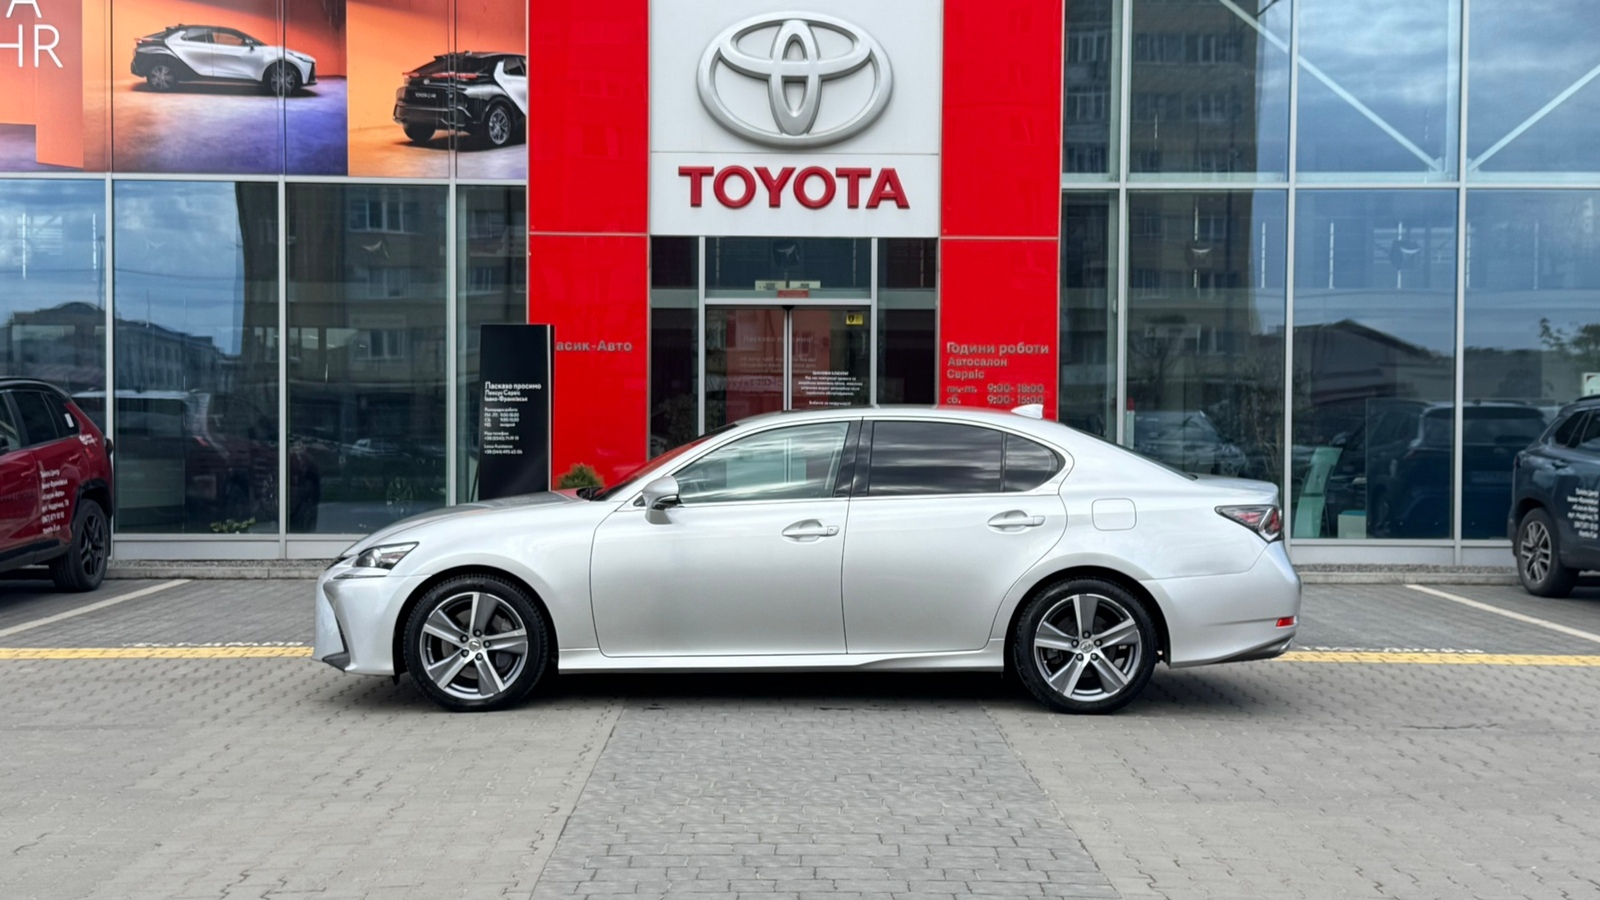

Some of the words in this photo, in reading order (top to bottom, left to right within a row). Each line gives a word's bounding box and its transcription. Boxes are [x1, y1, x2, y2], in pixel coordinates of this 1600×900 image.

[678, 165, 910, 209] TOYOTA
[947, 342, 995, 355] Години
[999, 342, 1049, 356] роботи
[947, 357, 1007, 367] Автосалон
[947, 369, 985, 381] Сервіс
[947, 394, 961, 404] сб.
